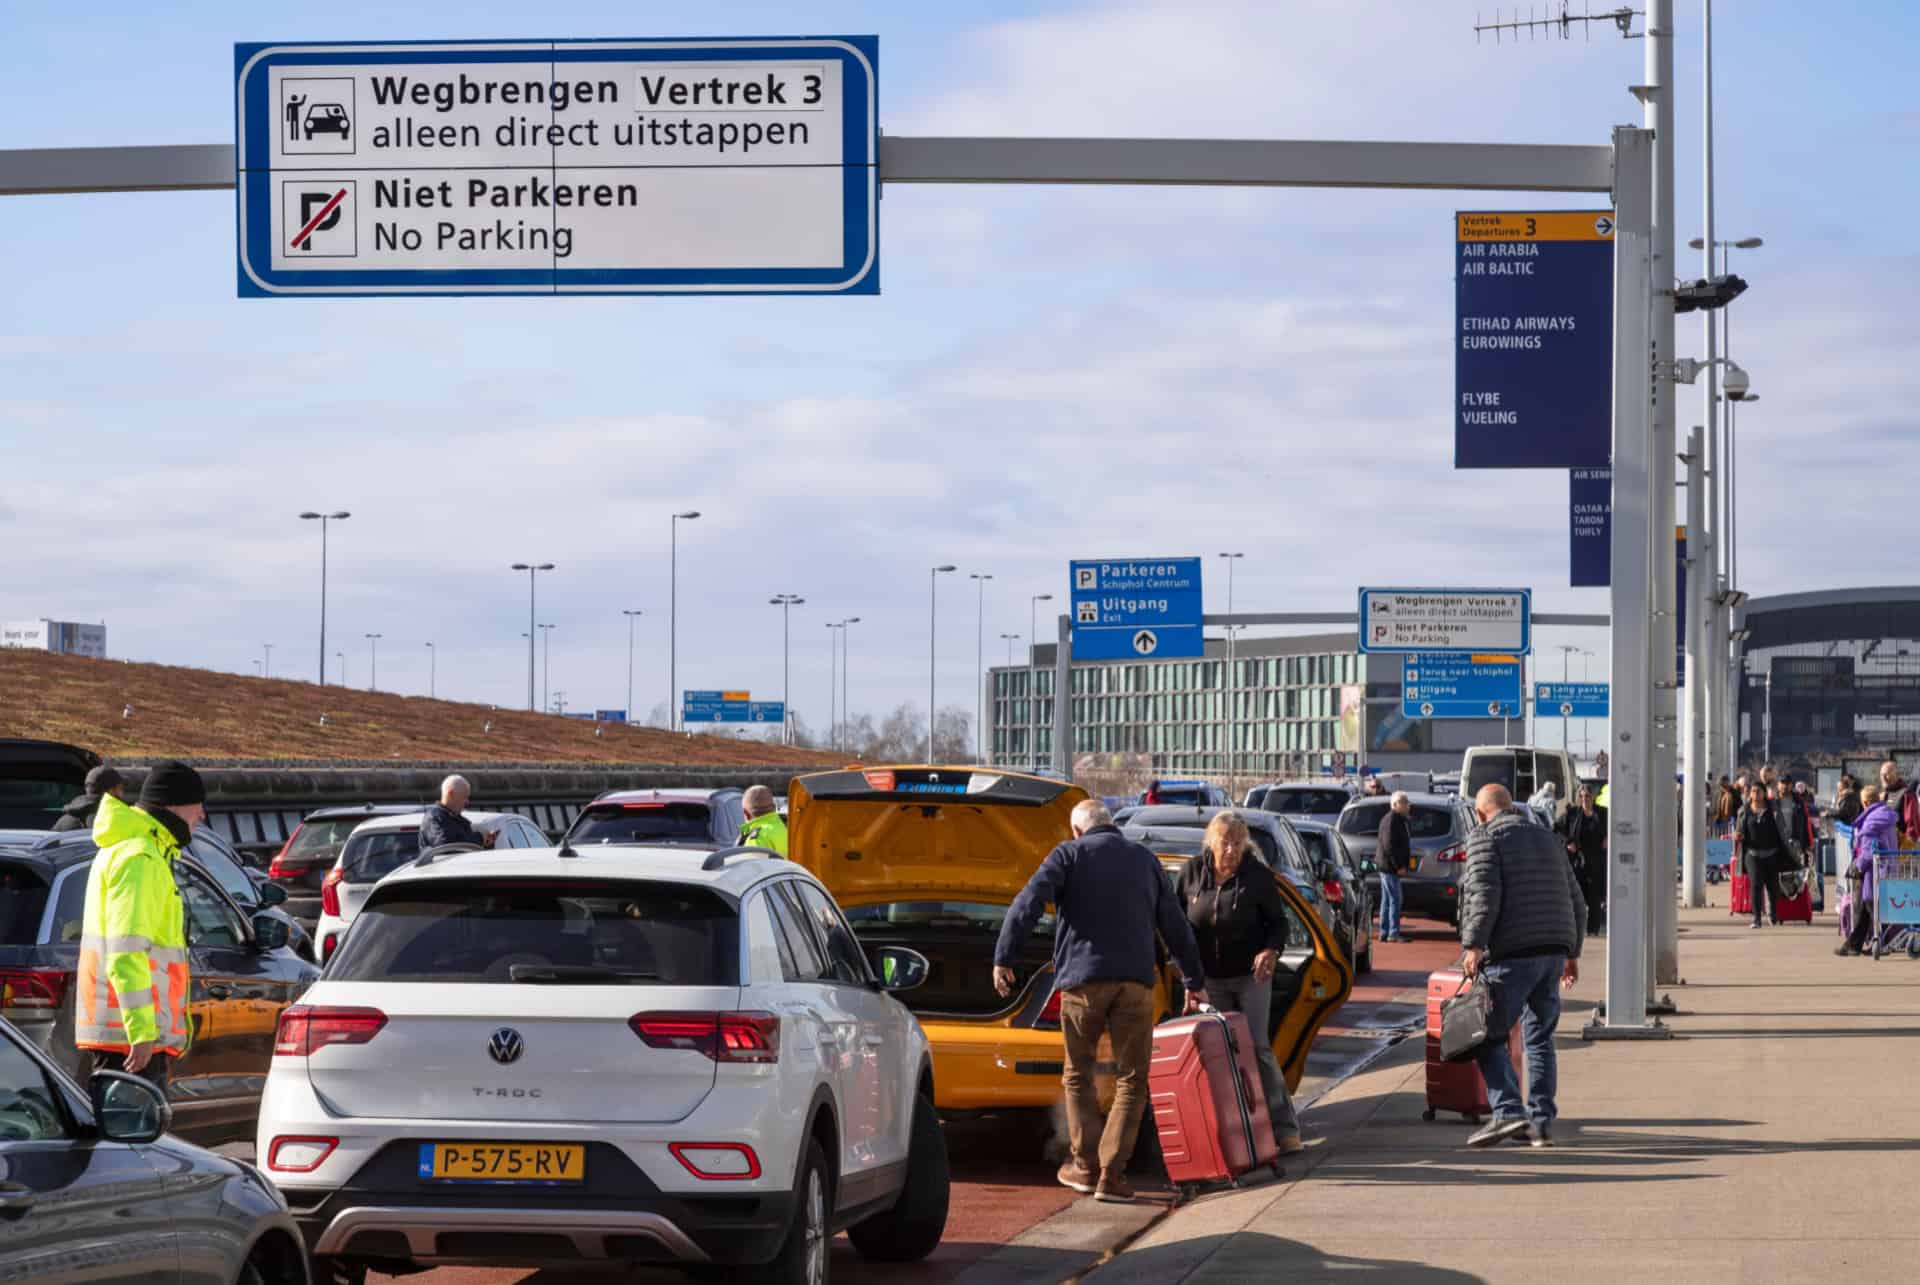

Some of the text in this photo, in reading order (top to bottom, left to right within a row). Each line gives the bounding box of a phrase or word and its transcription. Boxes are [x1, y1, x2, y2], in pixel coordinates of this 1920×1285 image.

[371, 73, 822, 112] Wegbrengen Vertrek 3
[372, 115, 809, 153] alleen direct uitstappen
[375, 176, 638, 208] Niet Parkeren
[1463, 216, 1501, 225] Vertrek
[1524, 218, 1537, 236] 3
[375, 220, 572, 257] No Parking
[1463, 227, 1520, 238] Departures
[1463, 243, 1539, 257] AIR ARABIA
[1463, 261, 1534, 275] AIR BALTIC
[1463, 316, 1576, 331] ETIHAD AIRWAYS
[1463, 336, 1542, 349] EUROWINGS
[1462, 392, 1501, 406] FLYBE
[1462, 411, 1518, 425] VUELING
[1101, 562, 1177, 577] Parkeren
[1102, 578, 1190, 591] Schiphol Centrum
[1102, 598, 1168, 614] Uitgang
[1103, 613, 1121, 622] Exit
[1395, 623, 1467, 633] Niet Parkeren
[472, 1087, 543, 1098] T-ROC
[420, 1163, 432, 1172] NL
[443, 1149, 571, 1175] P-575-RV
